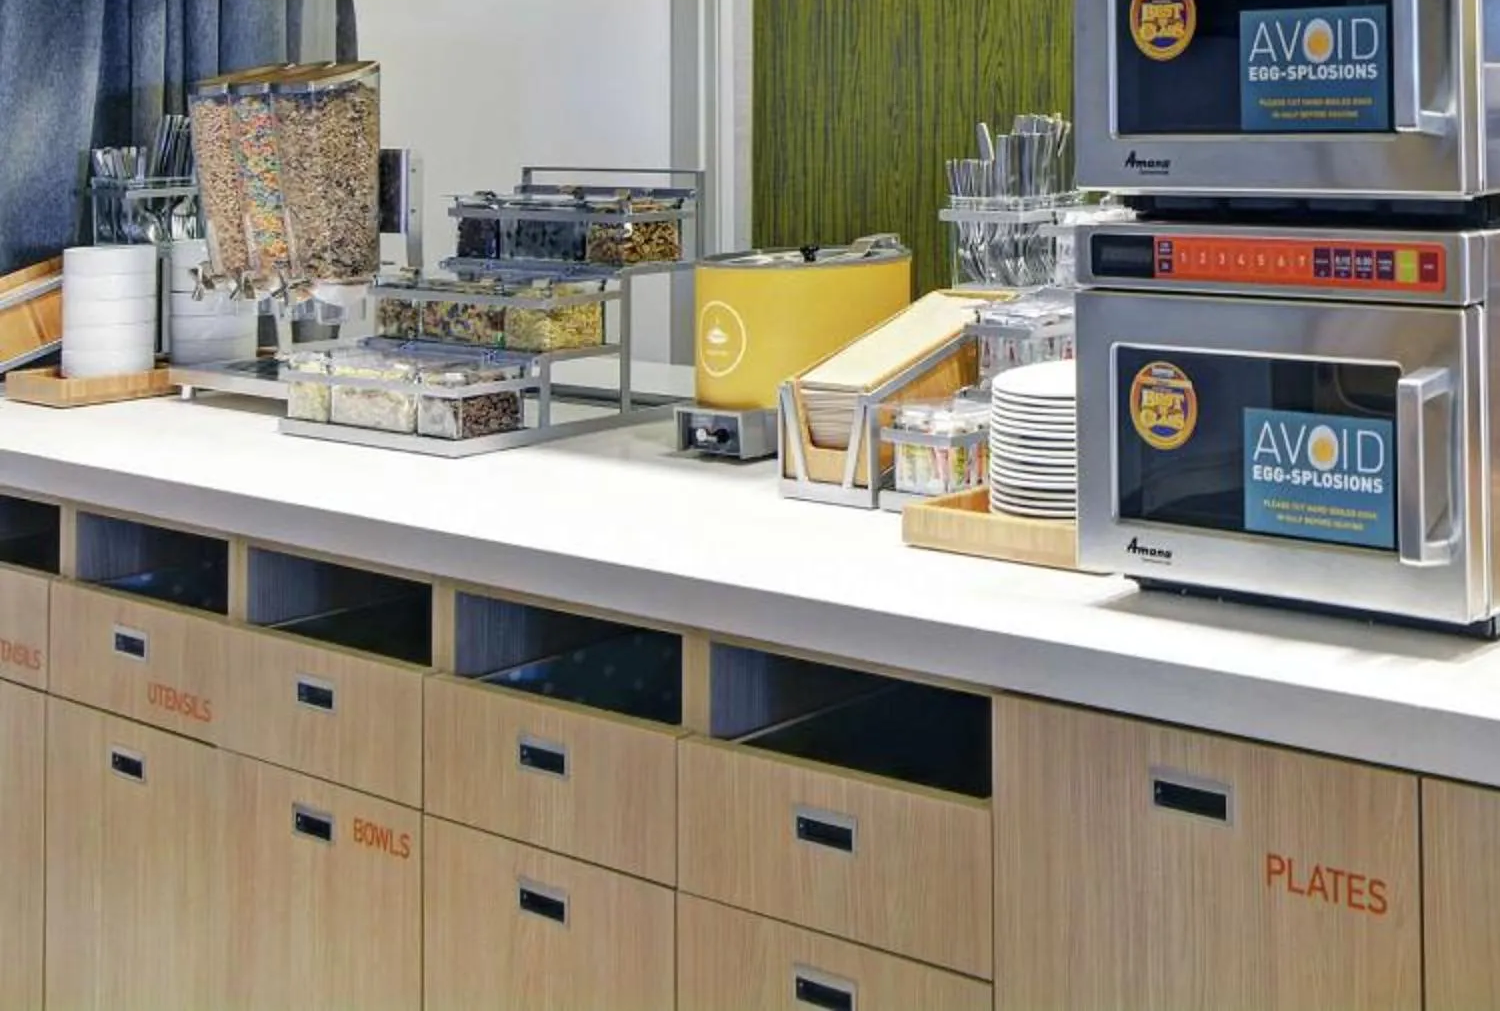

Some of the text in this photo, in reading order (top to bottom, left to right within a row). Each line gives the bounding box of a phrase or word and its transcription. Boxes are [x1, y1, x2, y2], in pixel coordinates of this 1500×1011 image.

[1249, 17, 1379, 63] AVOID
[1248, 63, 1379, 82] EGG-SPLOSIONS
[1253, 420, 1385, 473] AVOID
[1252, 464, 1383, 494] EGG-SPLOSIONS
[147, 681, 213, 724] UTENSILS
[353, 816, 411, 860] BOWLS
[1266, 853, 1388, 915] PLATES
